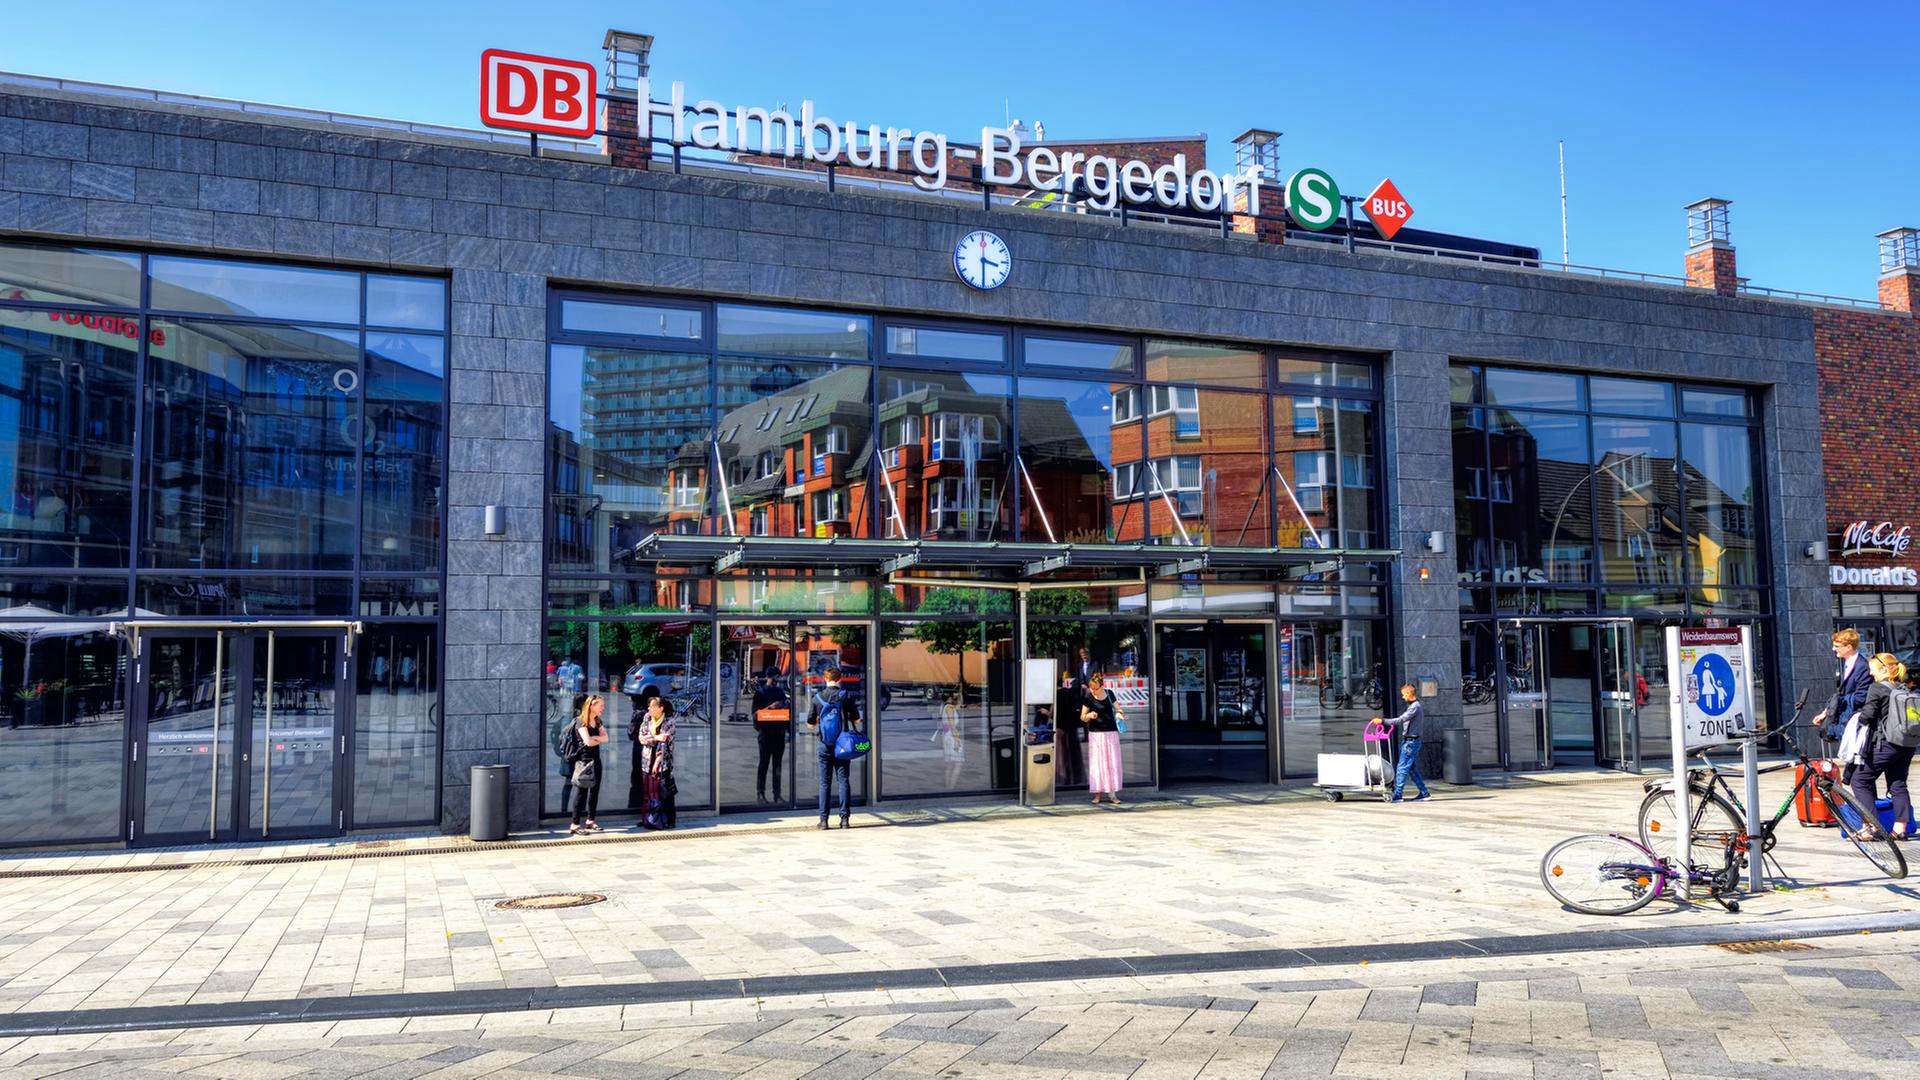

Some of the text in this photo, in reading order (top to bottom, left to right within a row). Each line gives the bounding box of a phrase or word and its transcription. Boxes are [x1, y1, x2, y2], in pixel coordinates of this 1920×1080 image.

[496, 62, 583, 122] DB
[637, 77, 1264, 216] Hamburg-Bergedorf
[1298, 173, 1333, 224] S
[1372, 198, 1407, 218] BUS
[1828, 565, 1918, 586] Donald's
[1681, 631, 1738, 642] Weidenbaumsweg
[1700, 719, 1732, 736] ZONE
